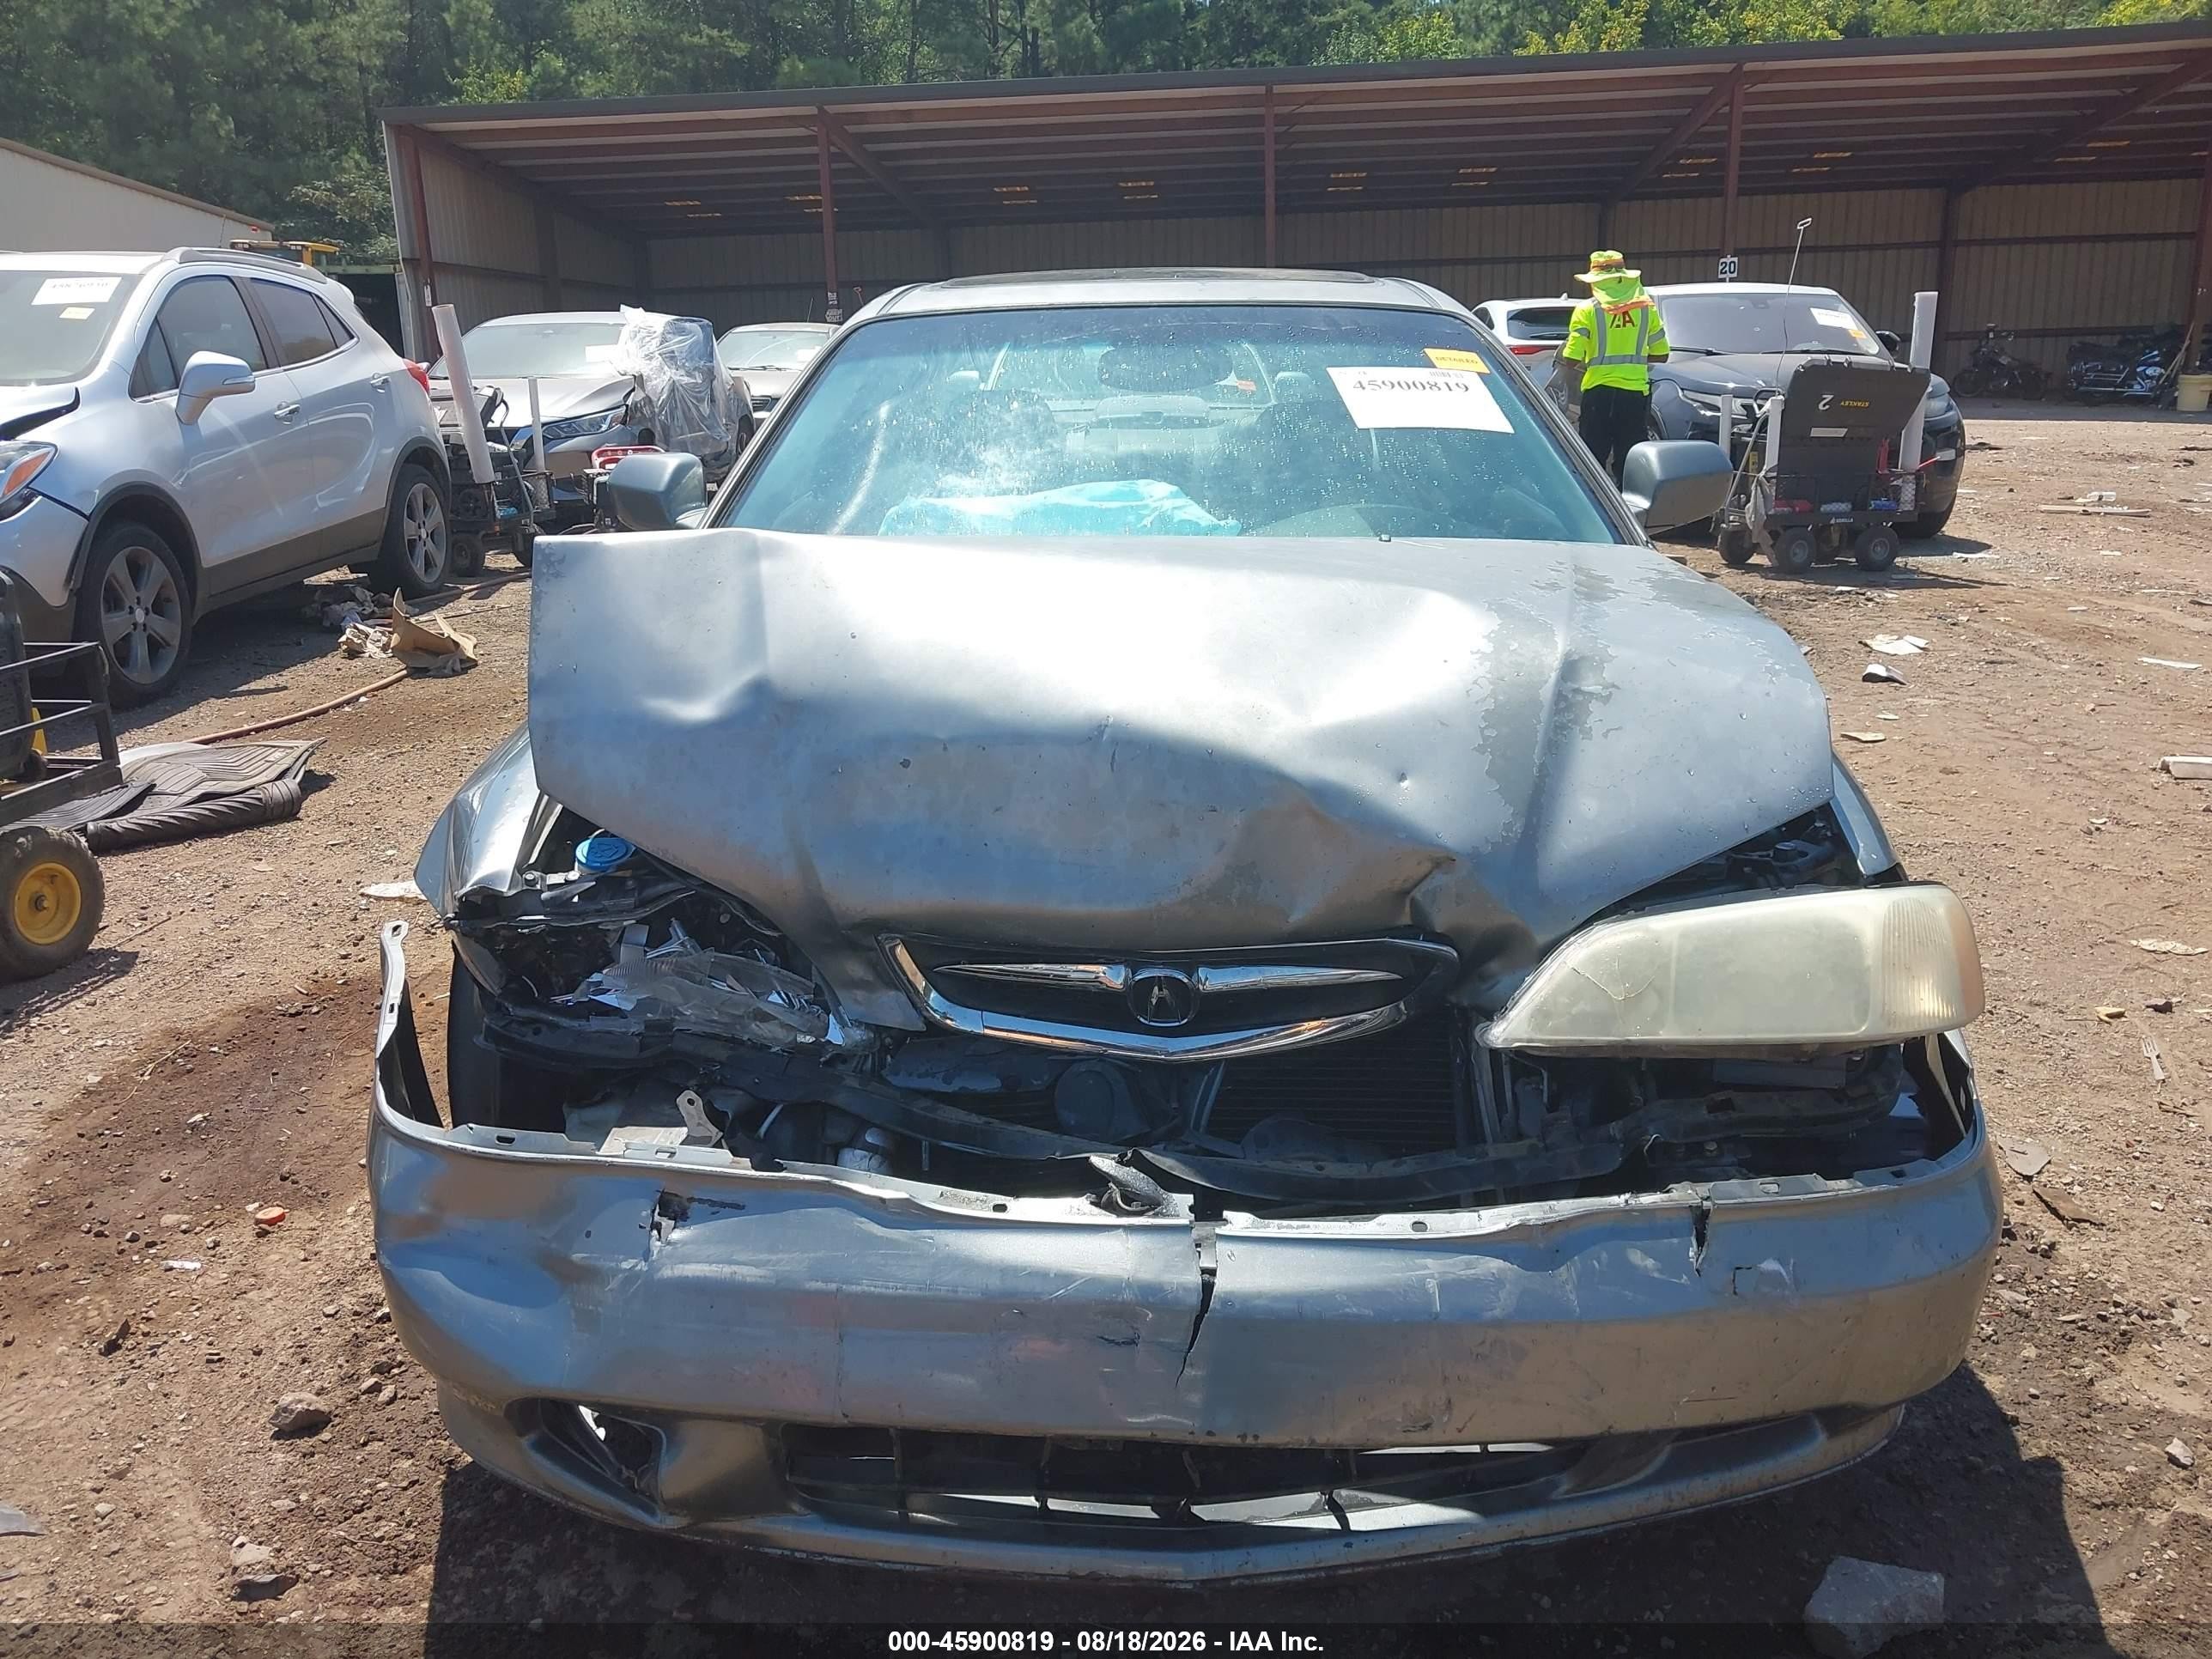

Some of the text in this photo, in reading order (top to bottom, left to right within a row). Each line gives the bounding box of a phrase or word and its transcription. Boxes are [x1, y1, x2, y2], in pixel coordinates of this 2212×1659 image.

[1720, 261, 1736, 275] 20
[1353, 380, 1469, 392] 45900819
[1818, 394, 1834, 410] 2
